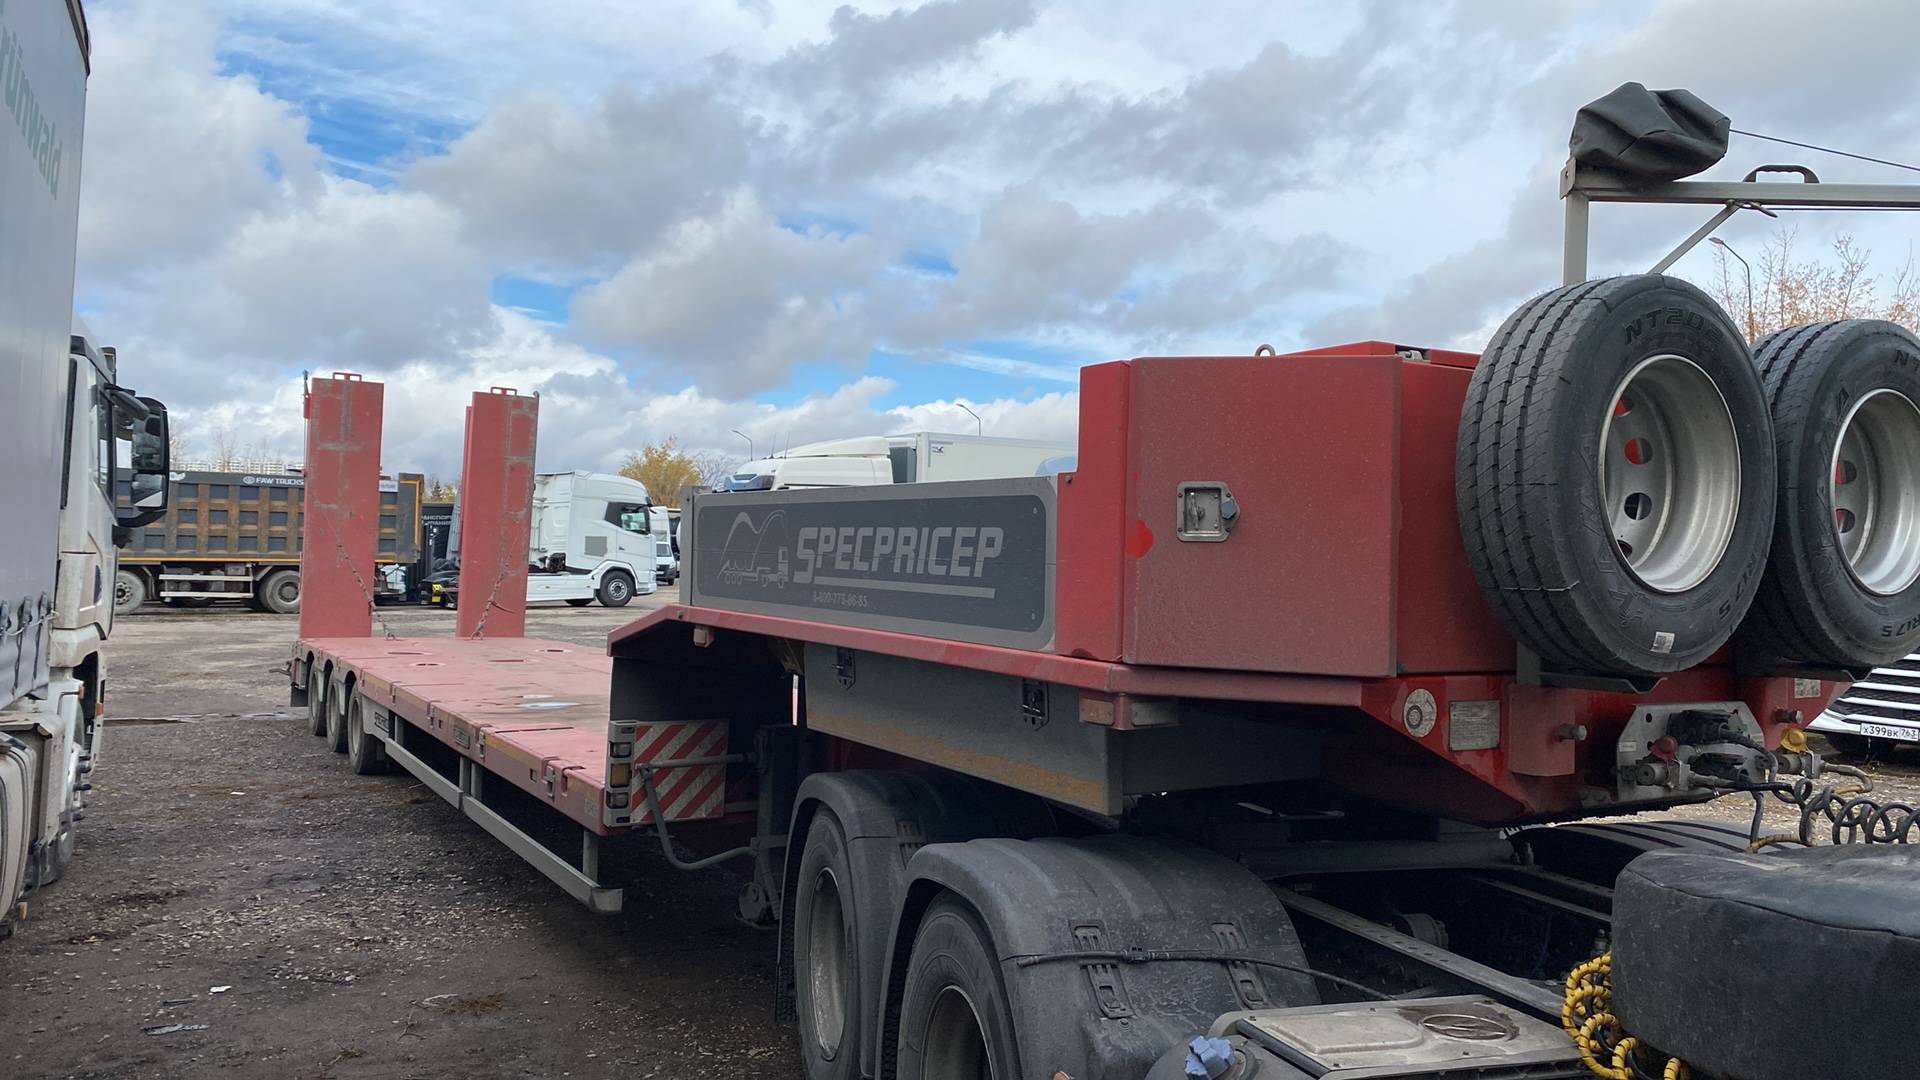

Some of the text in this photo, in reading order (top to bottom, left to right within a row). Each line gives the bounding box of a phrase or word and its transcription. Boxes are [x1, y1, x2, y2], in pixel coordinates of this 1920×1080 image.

[1624, 306, 1725, 346] NT202
[255, 477, 274, 485] FAW
[793, 526, 1005, 585] SPECPRICEP
[1901, 727, 1917, 738] 763
